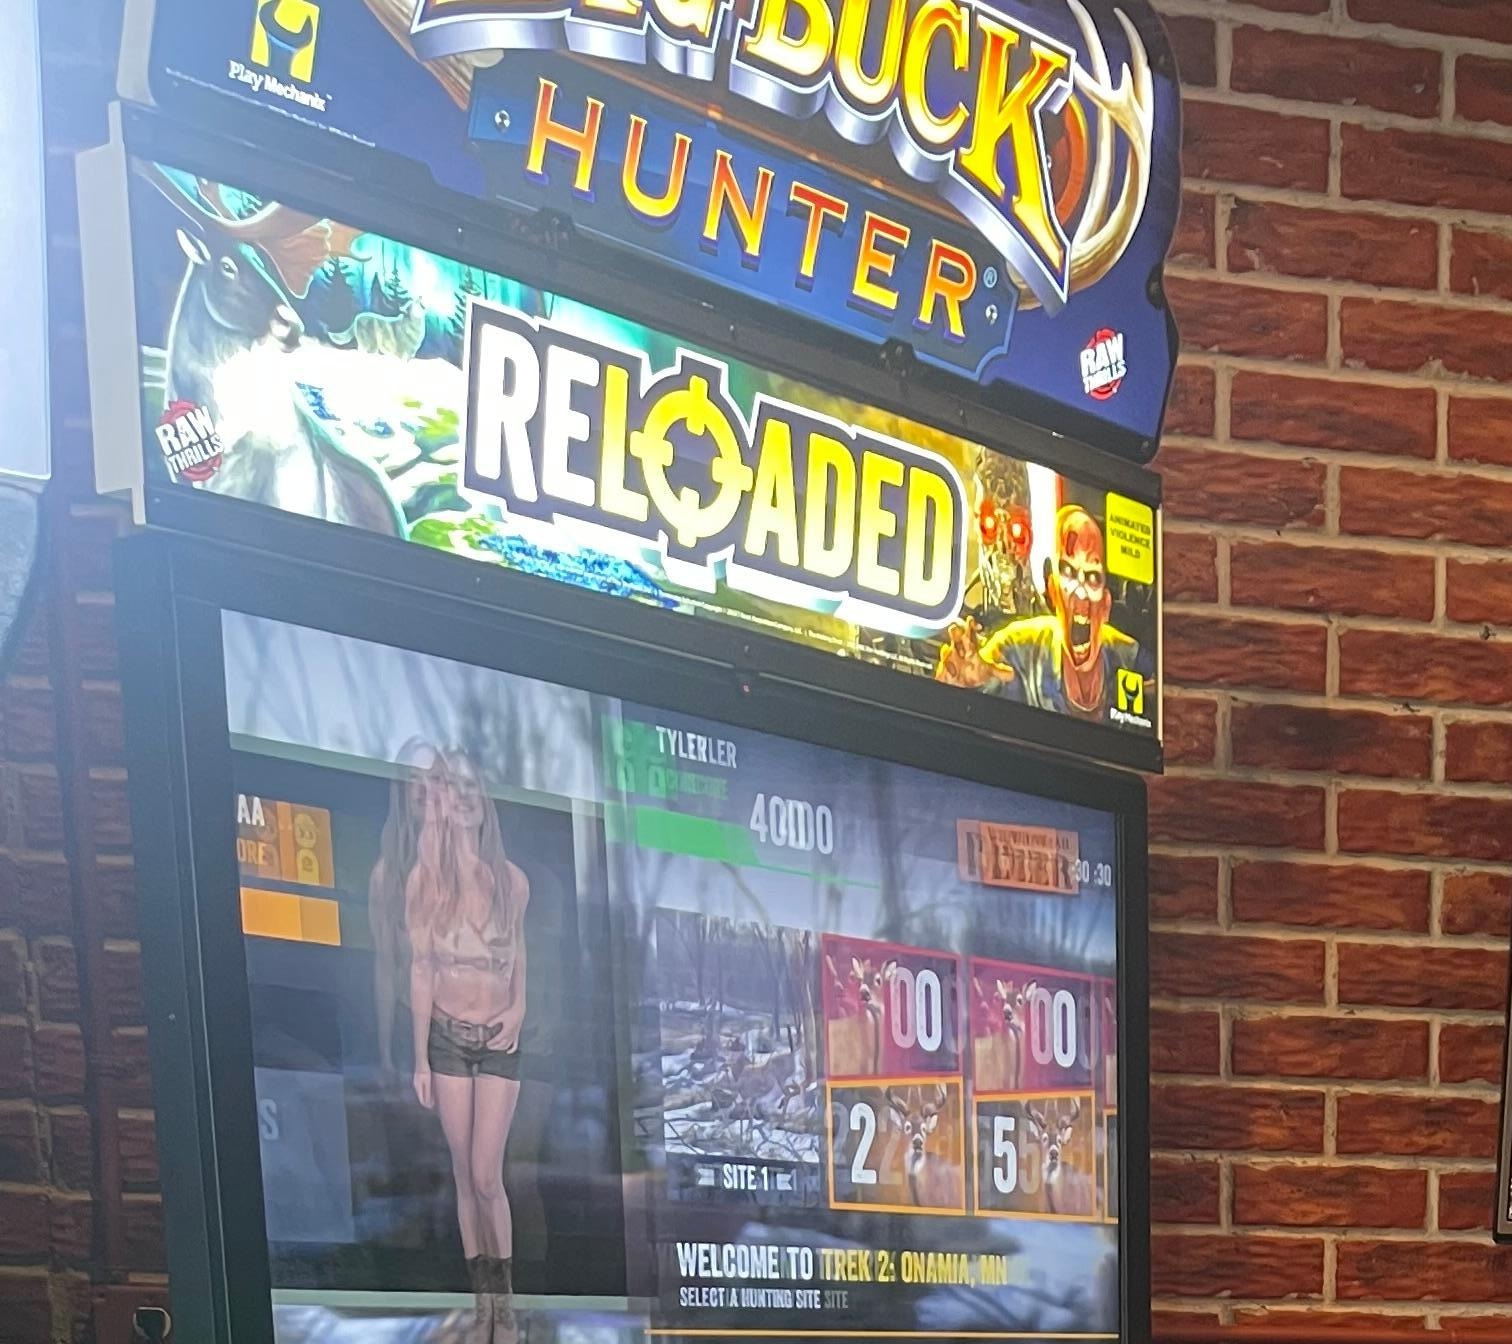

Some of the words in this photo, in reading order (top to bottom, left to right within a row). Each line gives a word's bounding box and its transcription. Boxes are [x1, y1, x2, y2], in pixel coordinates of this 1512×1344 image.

[526, 77, 980, 339] HUNTER
[155, 405, 215, 456] RAW
[167, 434, 225, 474] THRILLS
[475, 322, 955, 607] RELOADED
[723, 1163, 757, 1190] SITE
[676, 1242, 780, 1279] WELCOME
[786, 1246, 814, 1281] TO
[820, 1247, 872, 1283] TREK
[679, 1286, 726, 1307] SELECT
[795, 1289, 821, 1310] SITE
